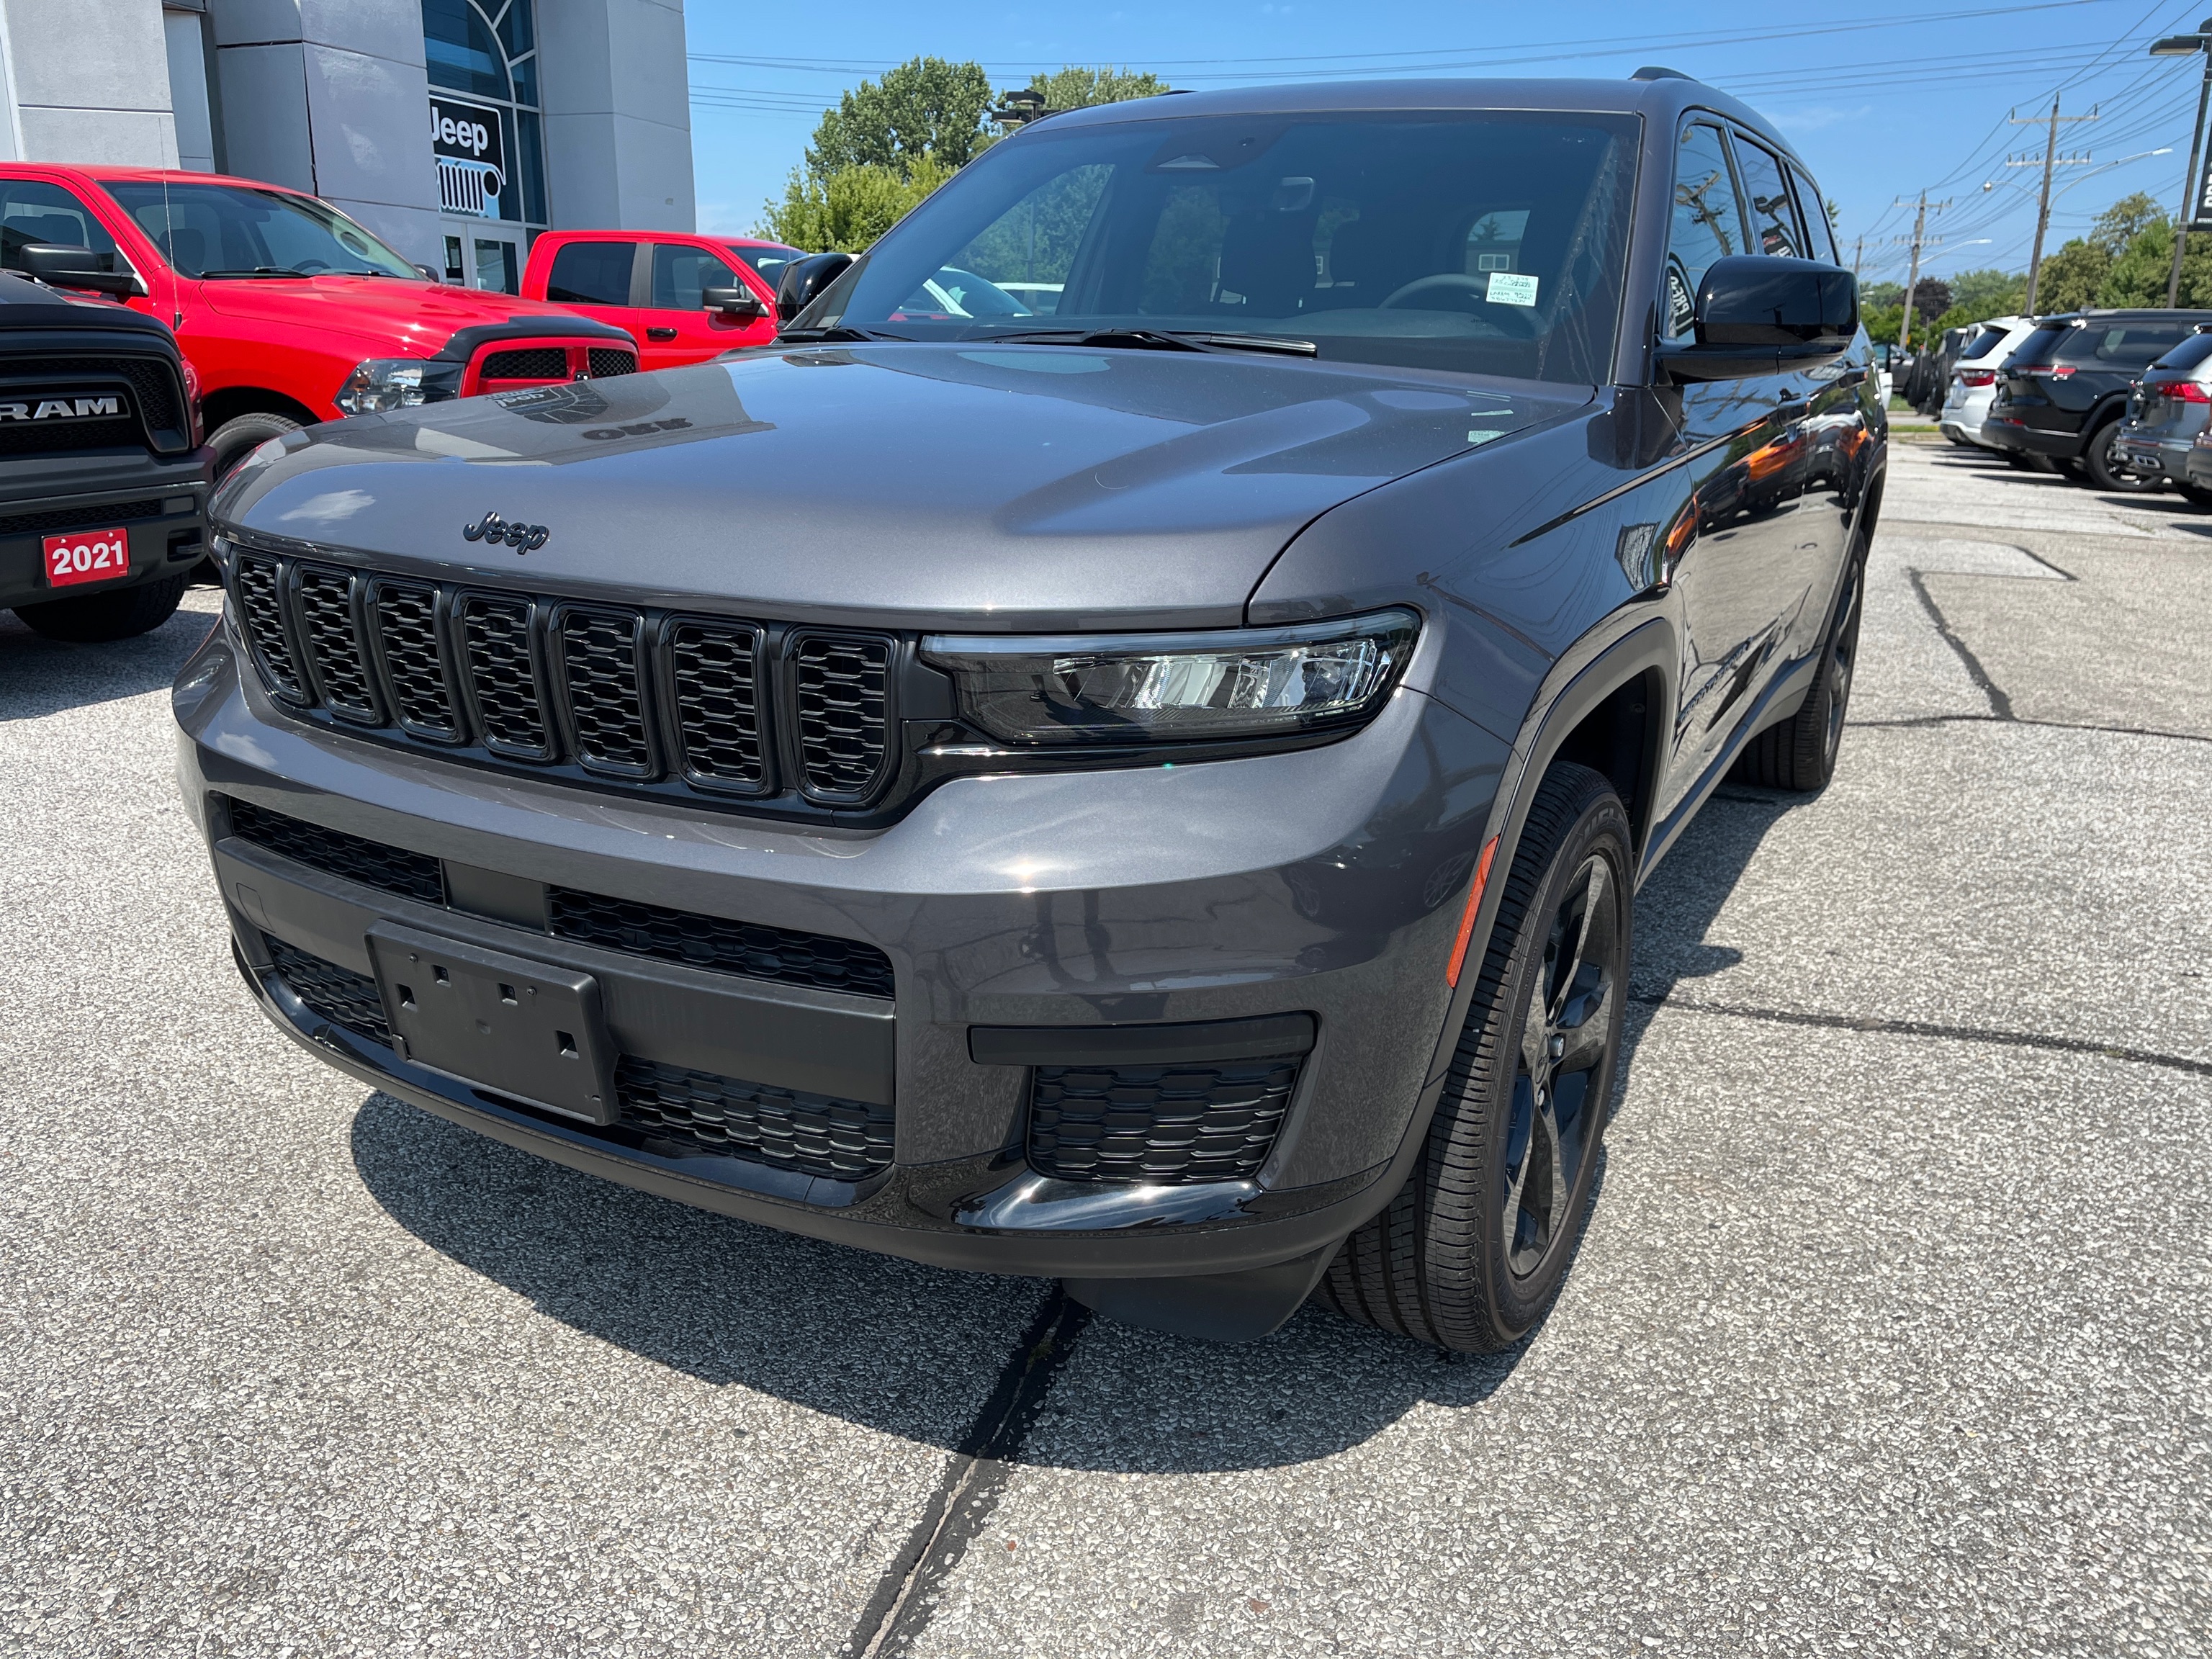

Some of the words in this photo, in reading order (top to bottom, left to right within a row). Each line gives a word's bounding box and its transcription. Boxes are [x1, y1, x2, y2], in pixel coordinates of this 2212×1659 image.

[431, 106, 488, 156] Jeep
[0, 397, 118, 421] RAM
[463, 511, 549, 555] Jeep
[52, 540, 124, 575] 2021
